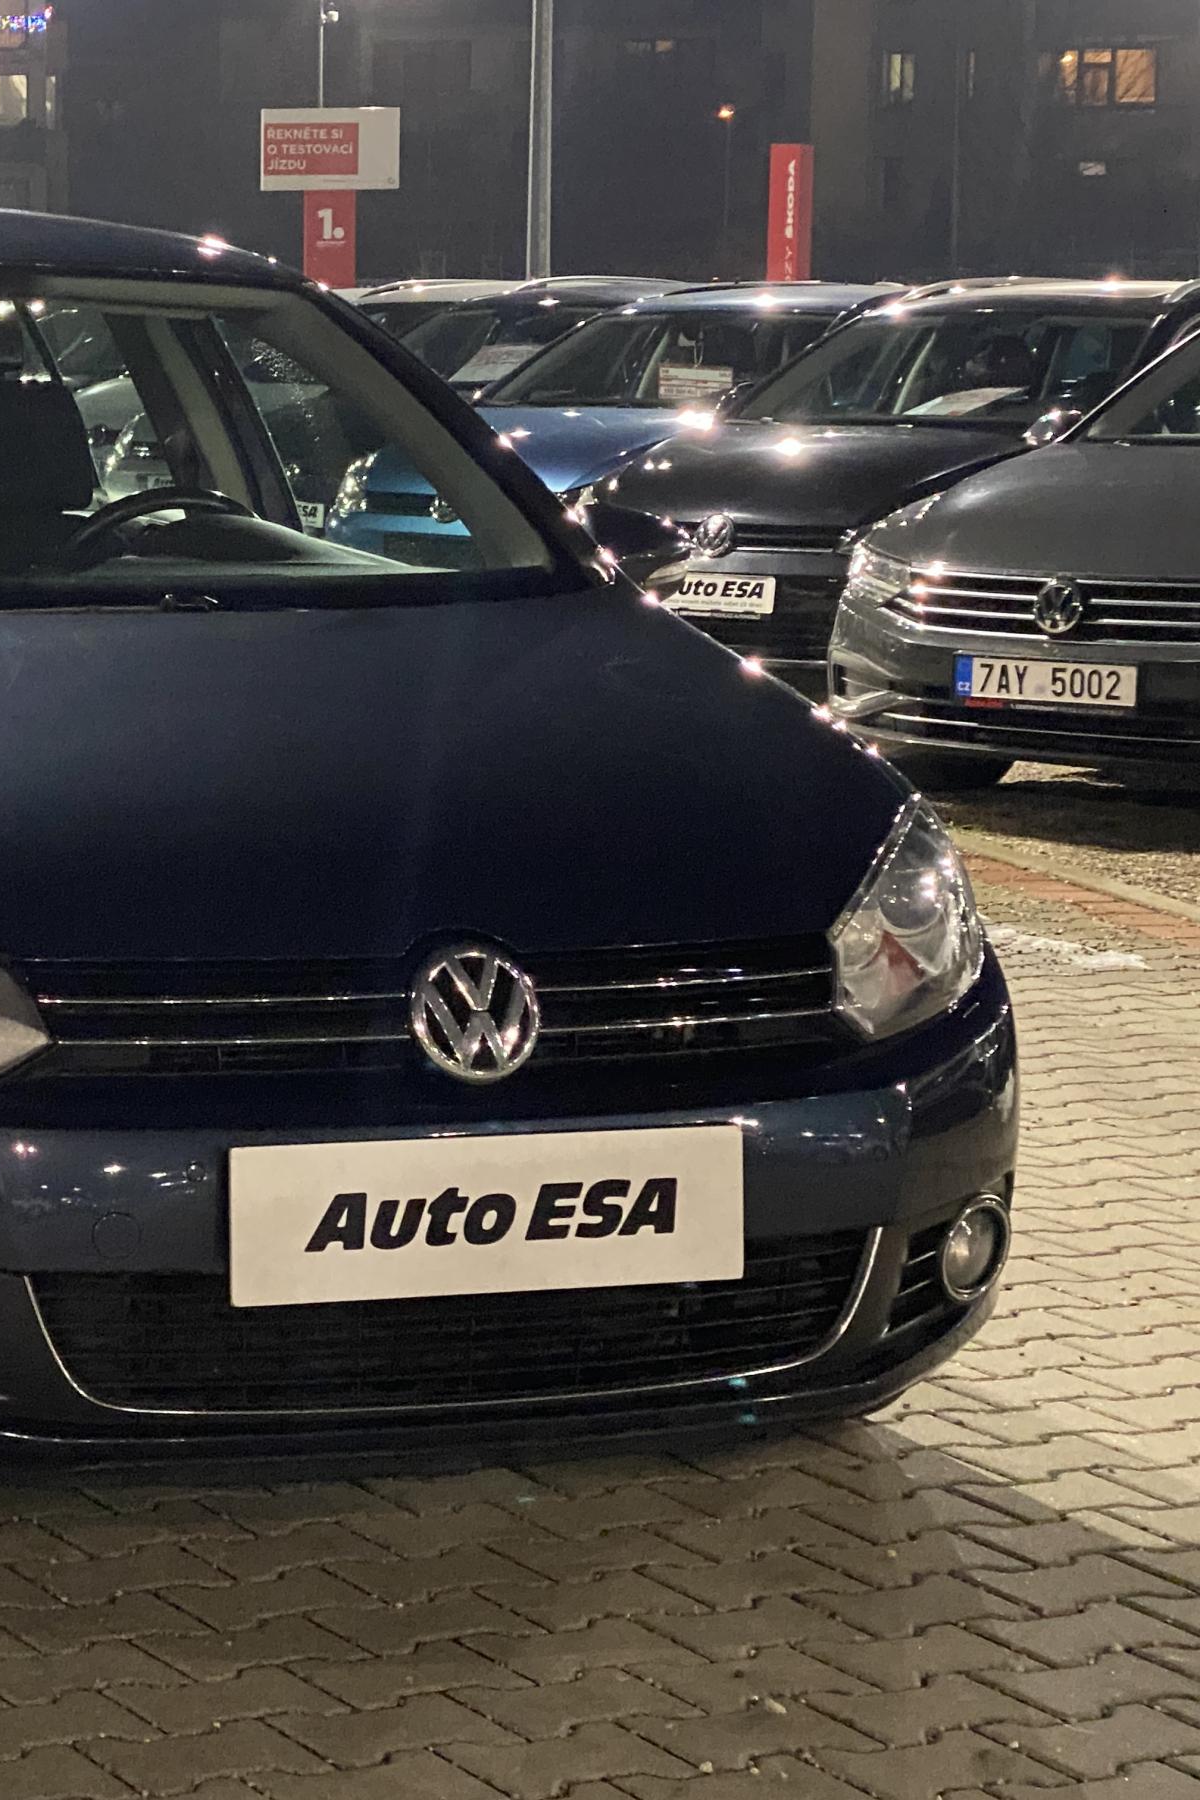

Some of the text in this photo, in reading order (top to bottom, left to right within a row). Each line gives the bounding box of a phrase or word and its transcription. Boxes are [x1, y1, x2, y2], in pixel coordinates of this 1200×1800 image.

[266, 126, 343, 139] ŘEKNĚTE SI
[267, 142, 353, 155] O TESTOVACÍ
[268, 157, 306, 170] JÍZDU
[317, 208, 345, 240] 1.
[678, 579, 765, 599] uto ESA
[957, 681, 970, 691] CZ
[980, 662, 1121, 700] 7AY 5002
[304, 1177, 678, 1253] Auto ESA
